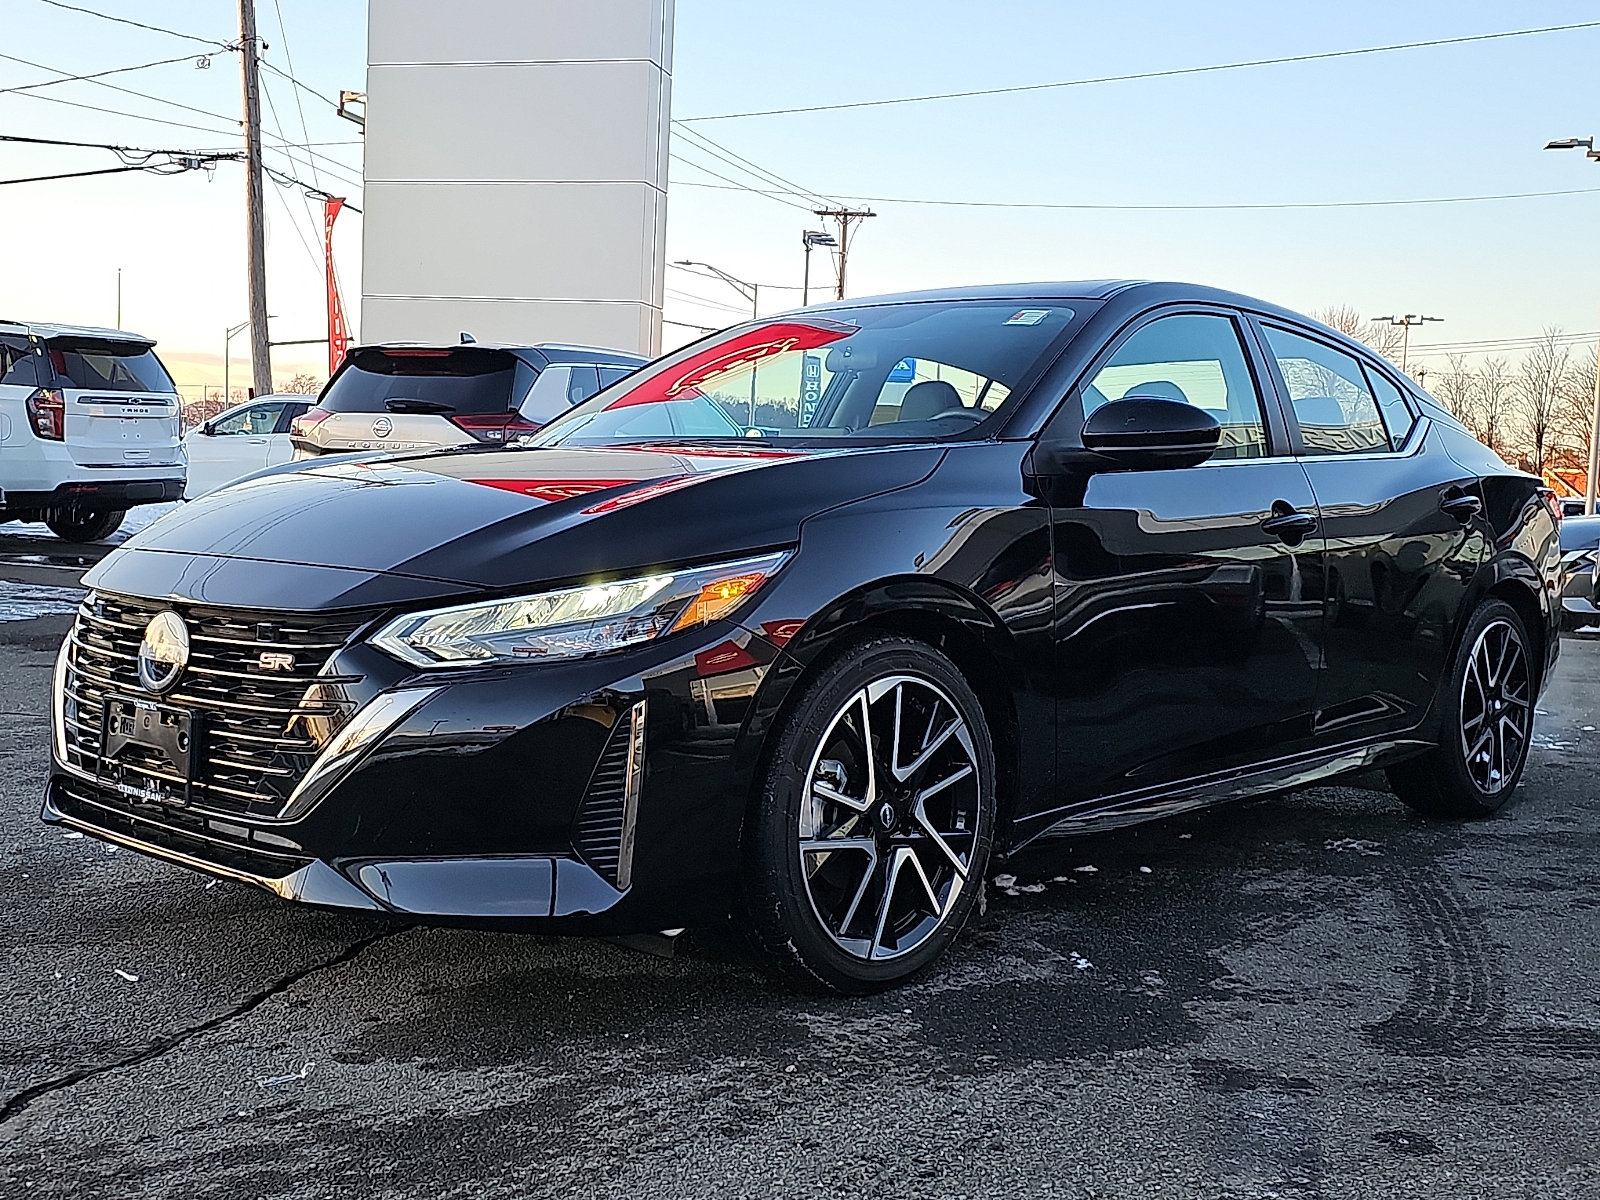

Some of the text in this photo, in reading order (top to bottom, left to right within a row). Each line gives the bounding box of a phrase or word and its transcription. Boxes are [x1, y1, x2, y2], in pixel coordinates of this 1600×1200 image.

[804, 380, 820, 428] HOND
[347, 442, 416, 450] ROGUE
[259, 651, 295, 671] SR
